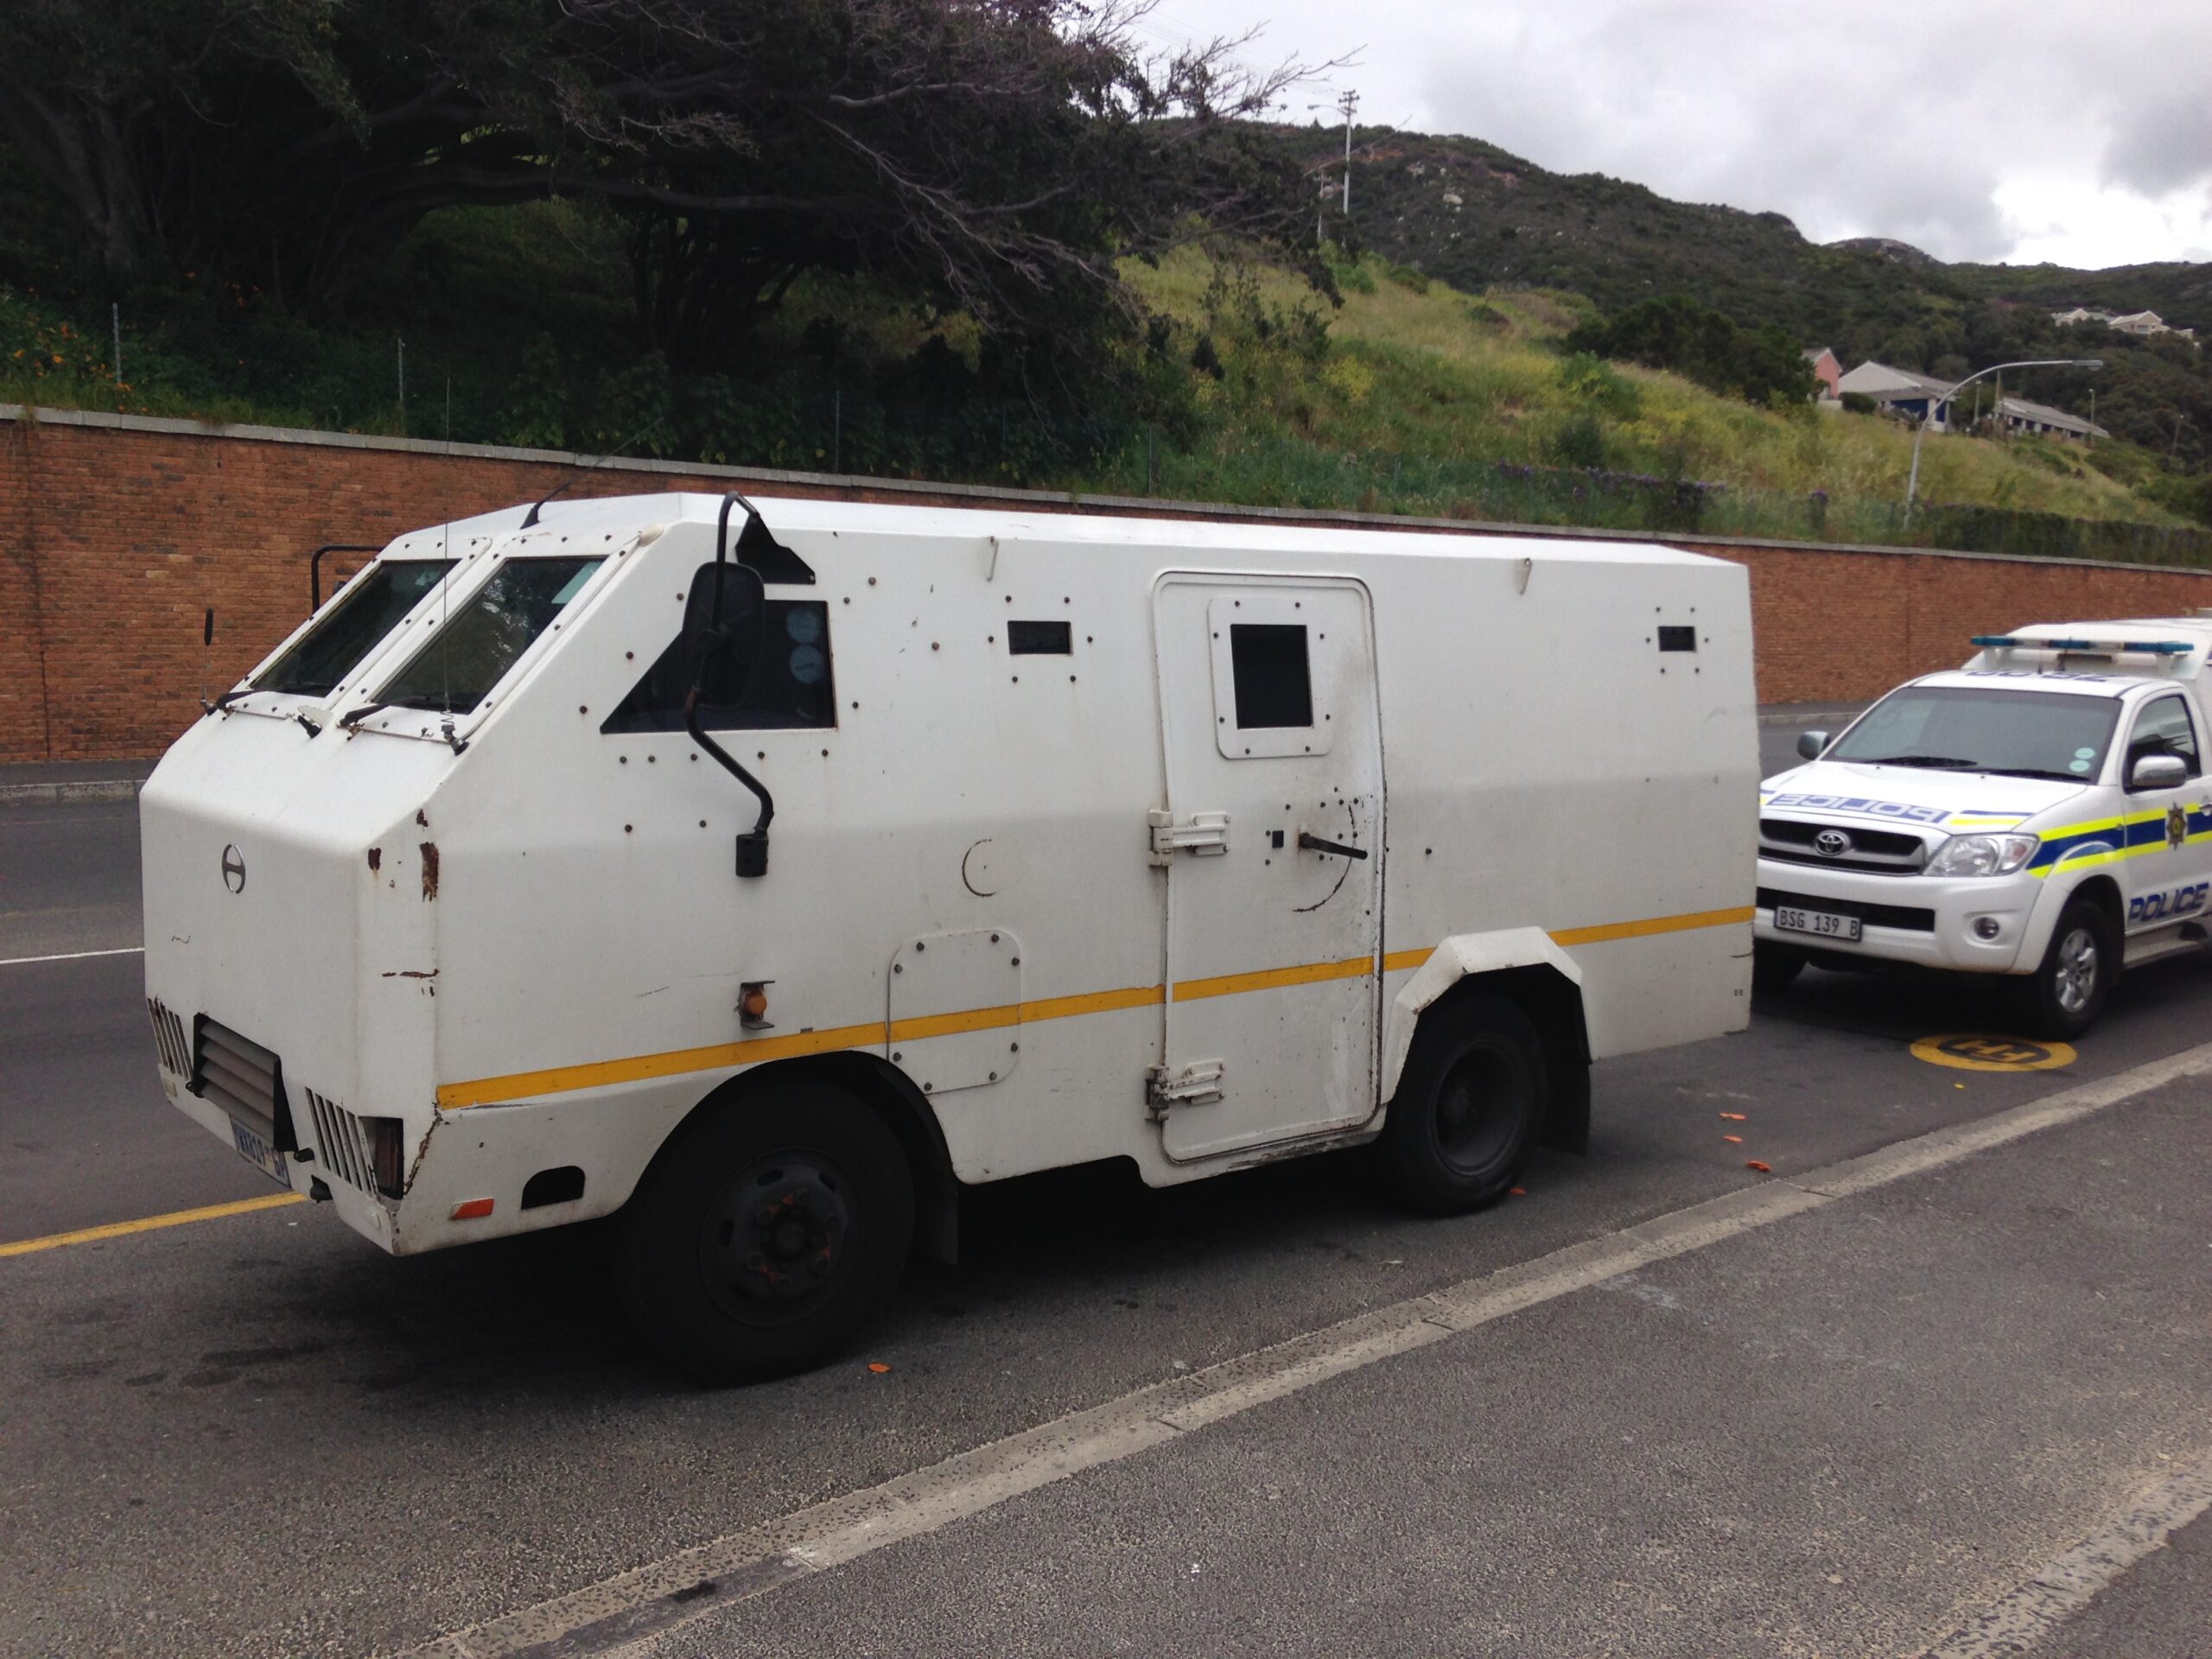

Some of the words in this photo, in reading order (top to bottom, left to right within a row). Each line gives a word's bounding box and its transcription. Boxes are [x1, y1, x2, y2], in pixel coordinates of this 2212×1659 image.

[2127, 882, 2209, 922] POLICE
[1779, 910, 1805, 927] BSG
[1813, 915, 1840, 933] 139
[1849, 919, 1859, 937] B
